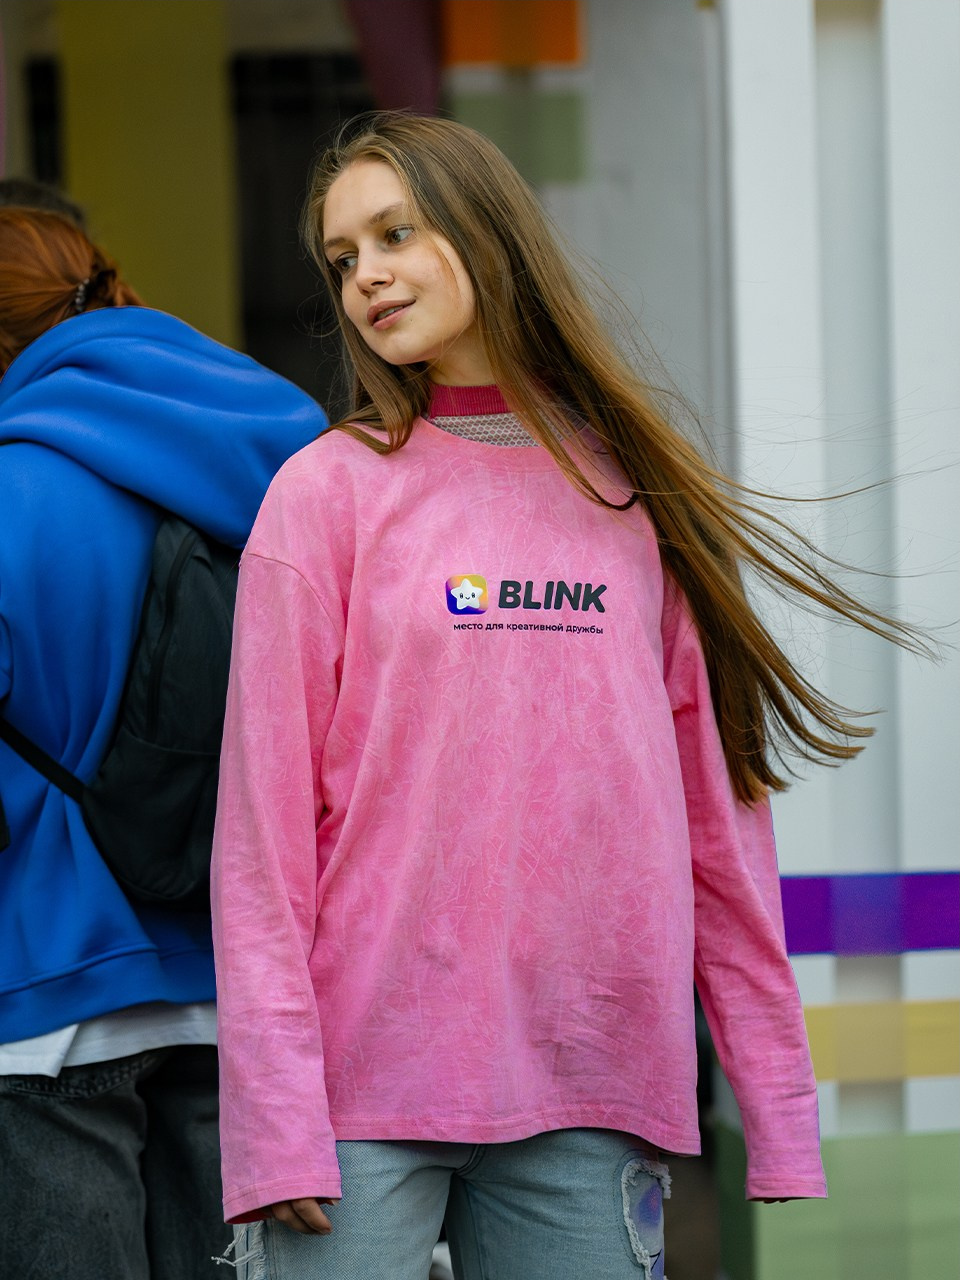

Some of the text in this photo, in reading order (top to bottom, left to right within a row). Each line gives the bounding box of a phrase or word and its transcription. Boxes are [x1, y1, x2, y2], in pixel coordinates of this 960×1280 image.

[498, 580, 607, 613] BLINK
[453, 622, 604, 635] место для креативной дружбы
